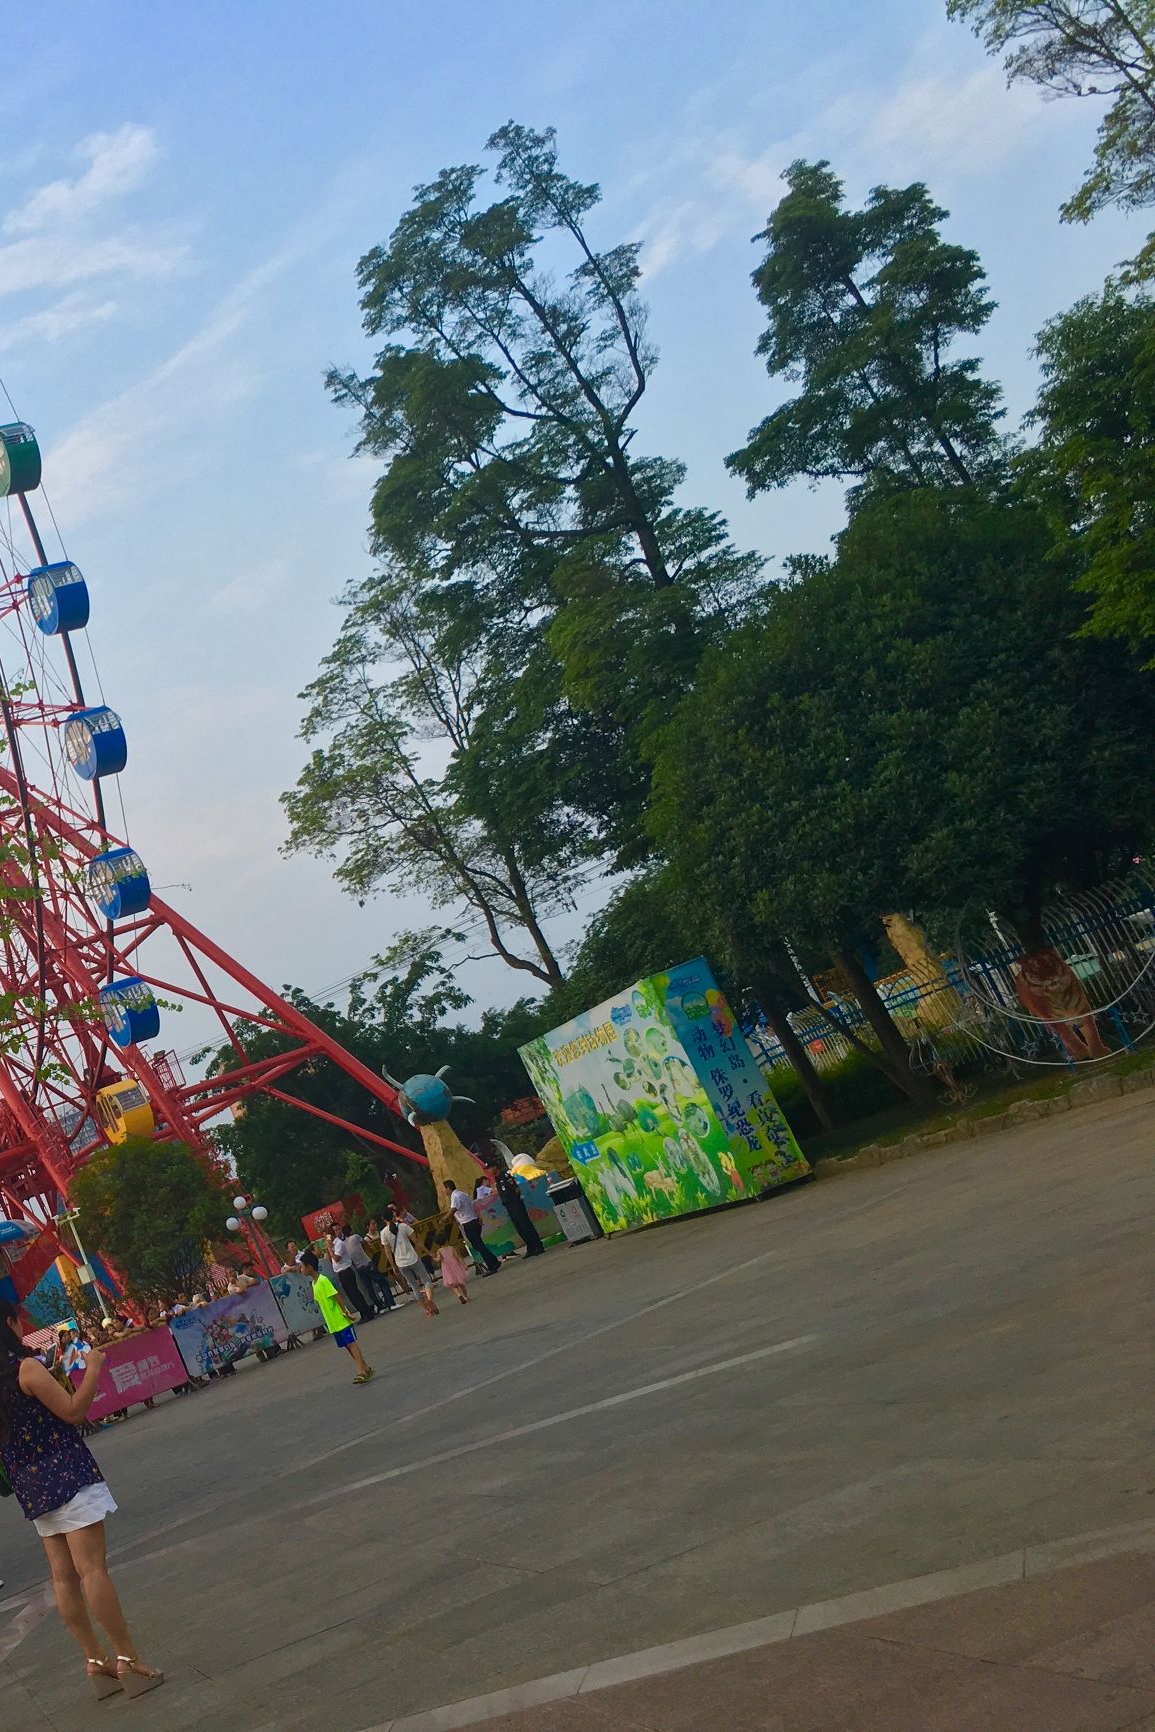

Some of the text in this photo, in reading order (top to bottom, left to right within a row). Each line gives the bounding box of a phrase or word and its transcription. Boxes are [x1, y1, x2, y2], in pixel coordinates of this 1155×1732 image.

[693, 1026, 762, 1152] 动物 侏罗纪恐龙
